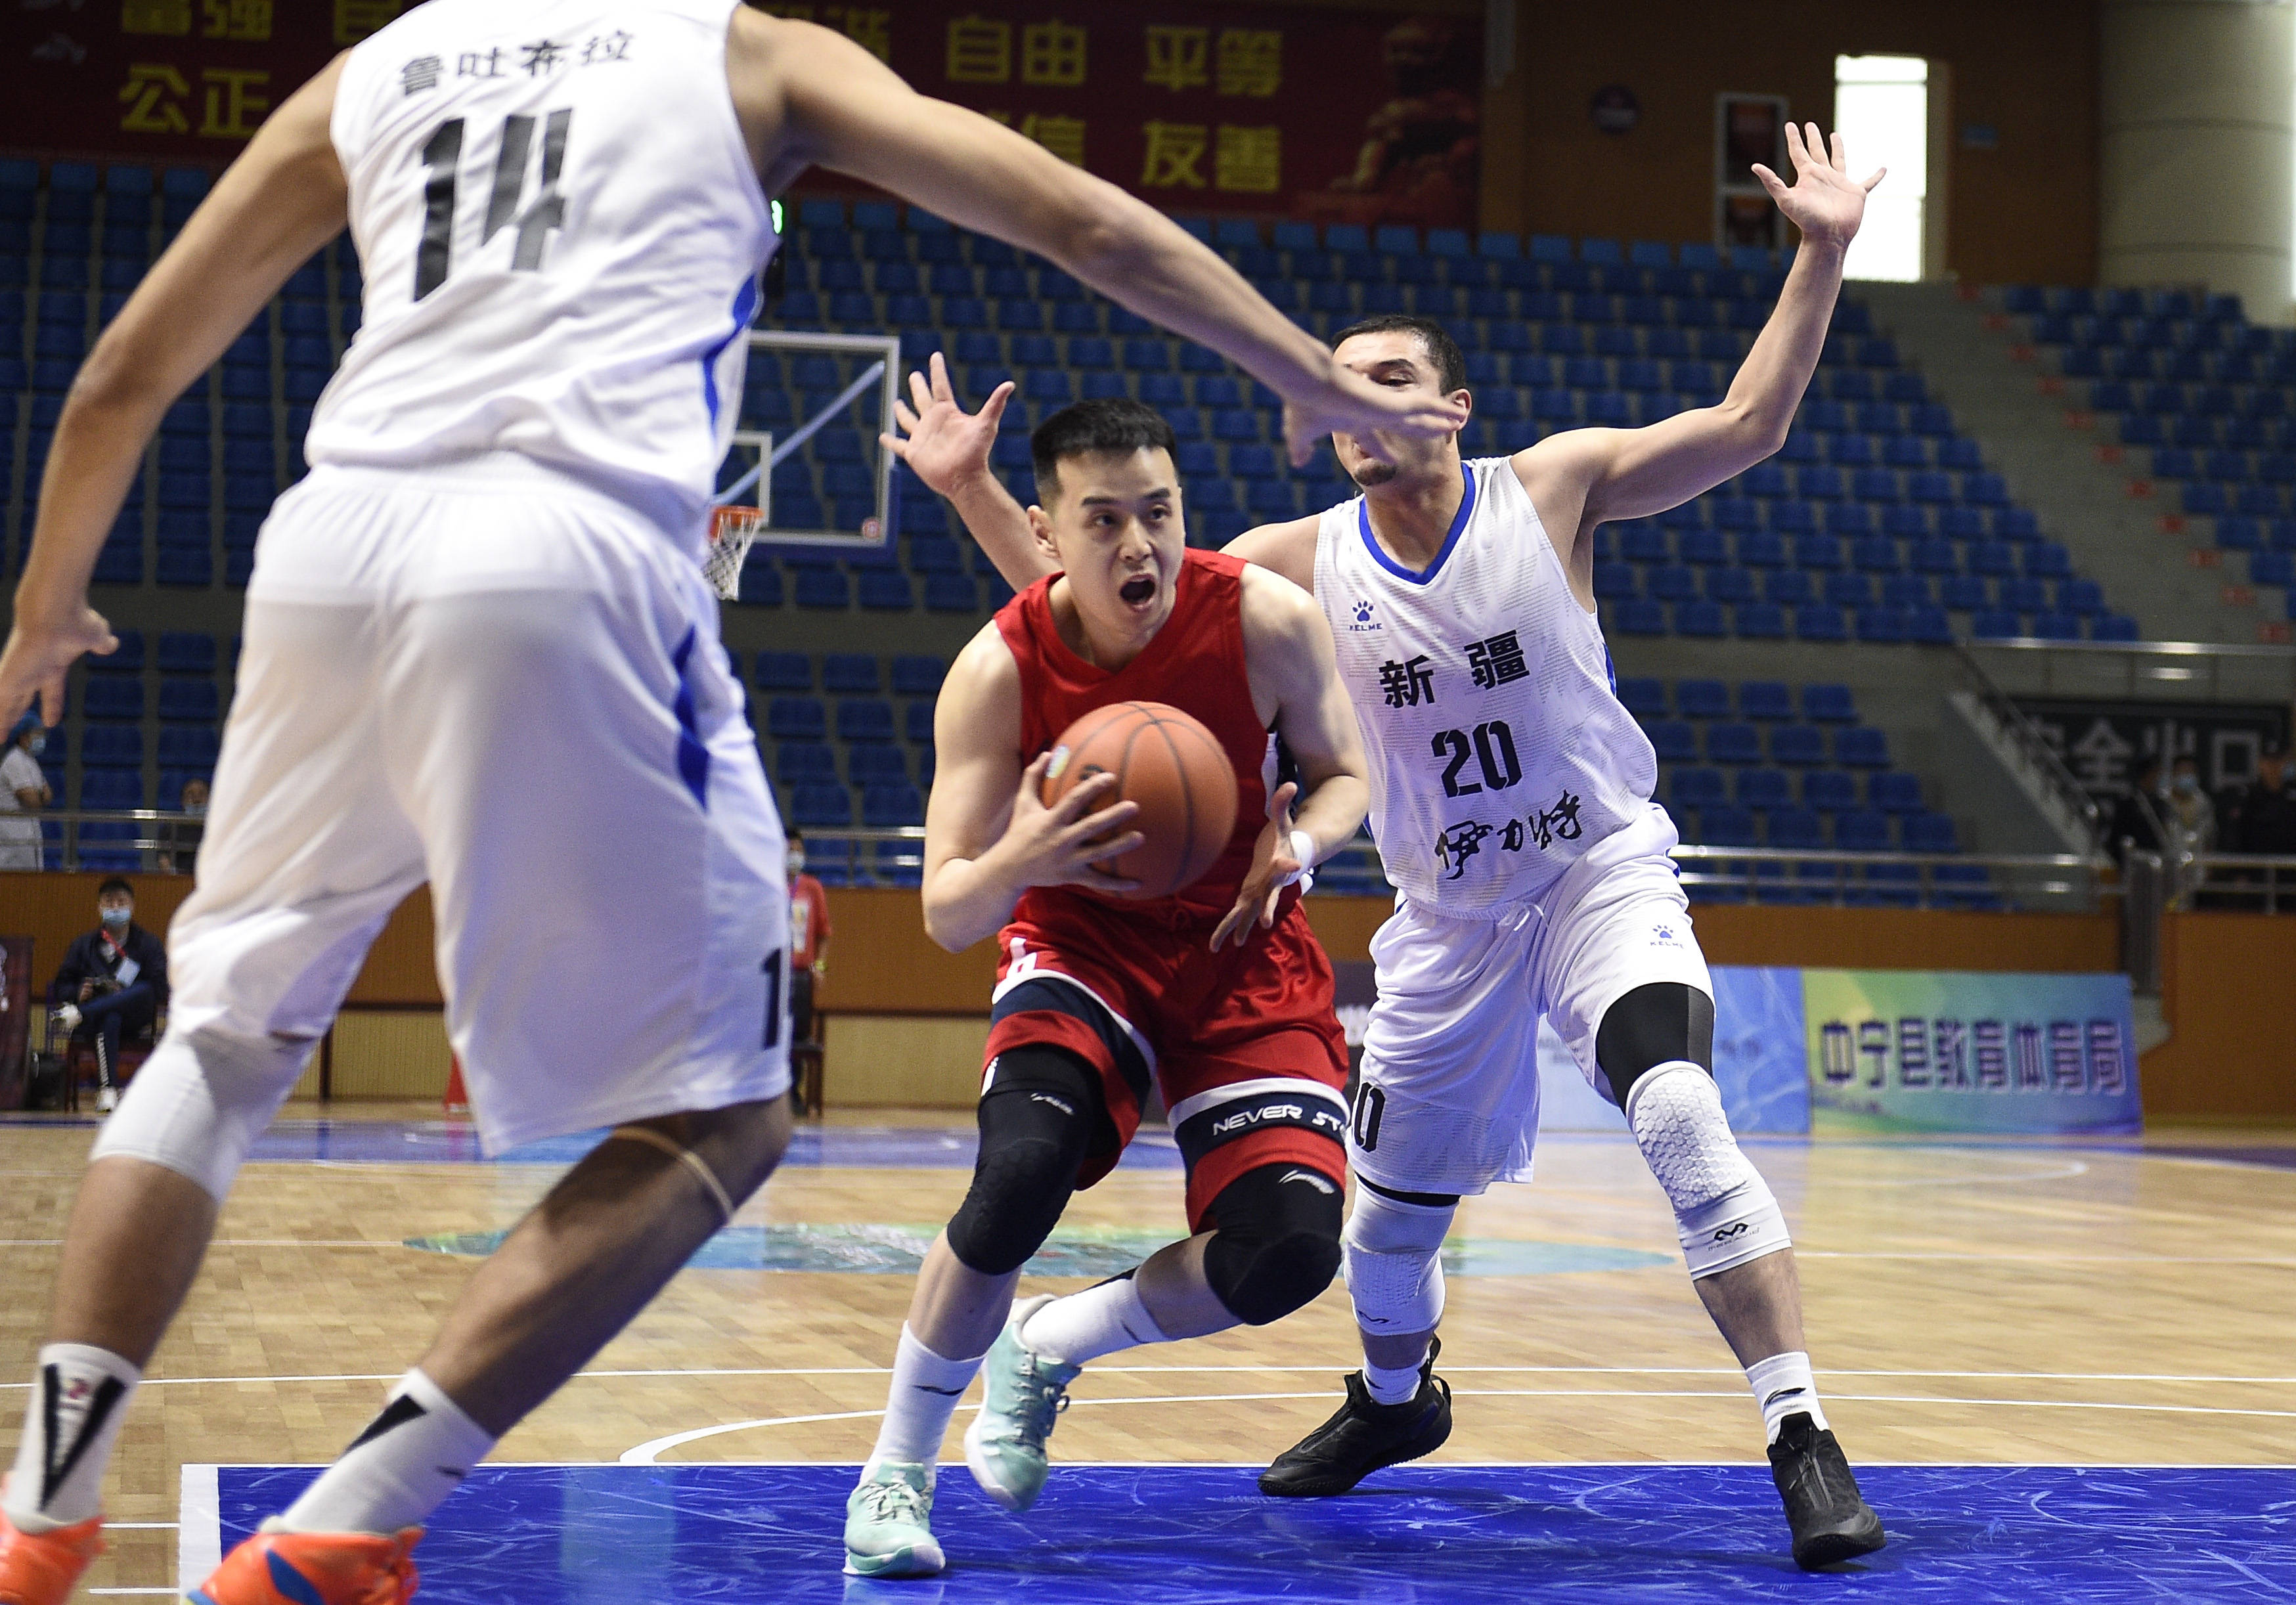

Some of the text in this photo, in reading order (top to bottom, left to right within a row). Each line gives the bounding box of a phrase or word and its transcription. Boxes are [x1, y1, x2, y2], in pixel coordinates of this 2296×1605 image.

[946, 16, 1088, 87] 自由
[1143, 25, 1283, 99] 平等
[118, 62, 1283, 194] 公正 信 友善
[413, 107, 573, 303] 14
[1349, 623, 1383, 632] KELME
[1379, 629, 1530, 709] 新疆
[1430, 720, 1523, 799] 20
[1822, 1017, 2125, 1095] 中宁县教育体育局
[1212, 1104, 1304, 1136] NEVER
